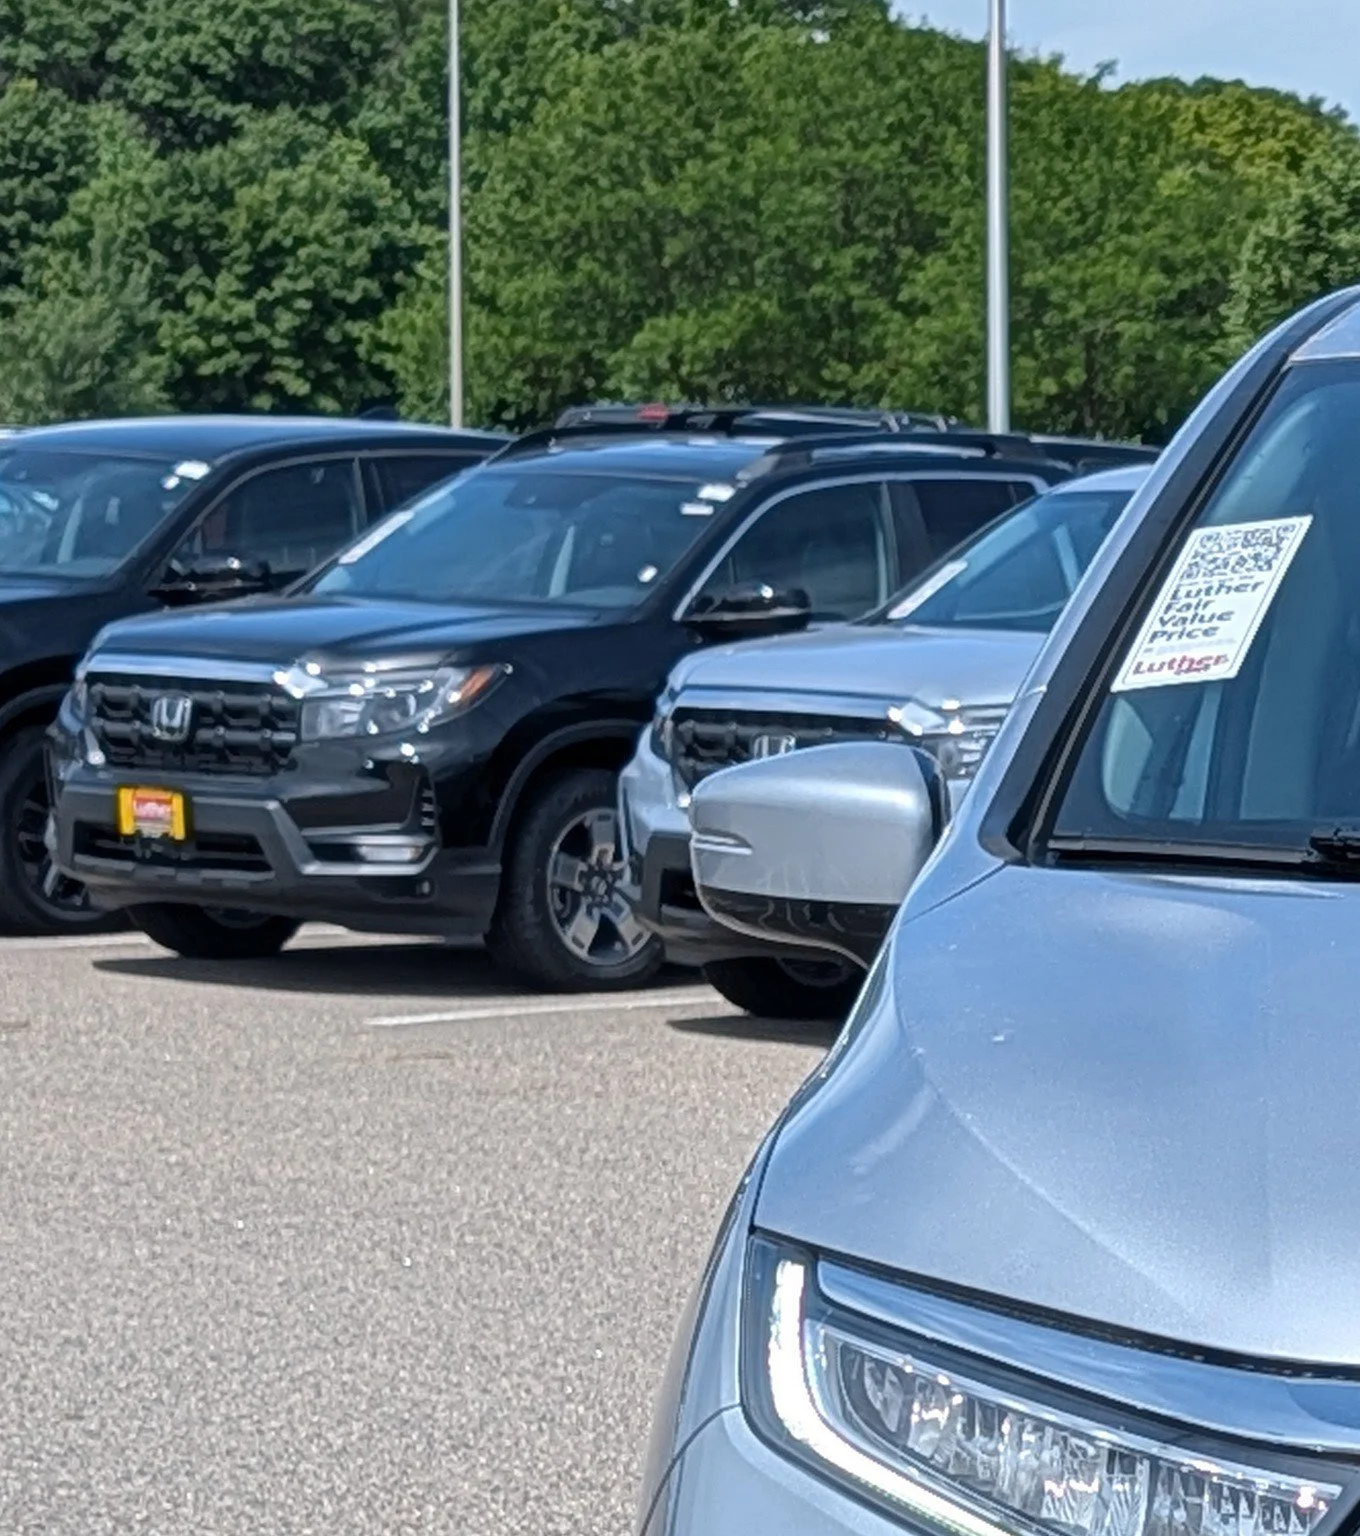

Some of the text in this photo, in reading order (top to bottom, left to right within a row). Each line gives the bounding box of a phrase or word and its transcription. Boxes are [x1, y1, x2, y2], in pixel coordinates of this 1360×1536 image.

[1170, 579, 1265, 601] Luther
[1163, 599, 1216, 615] Fair
[1158, 609, 1235, 628] Value
[1148, 626, 1220, 645] Price
[1132, 654, 1229, 675] Luther
